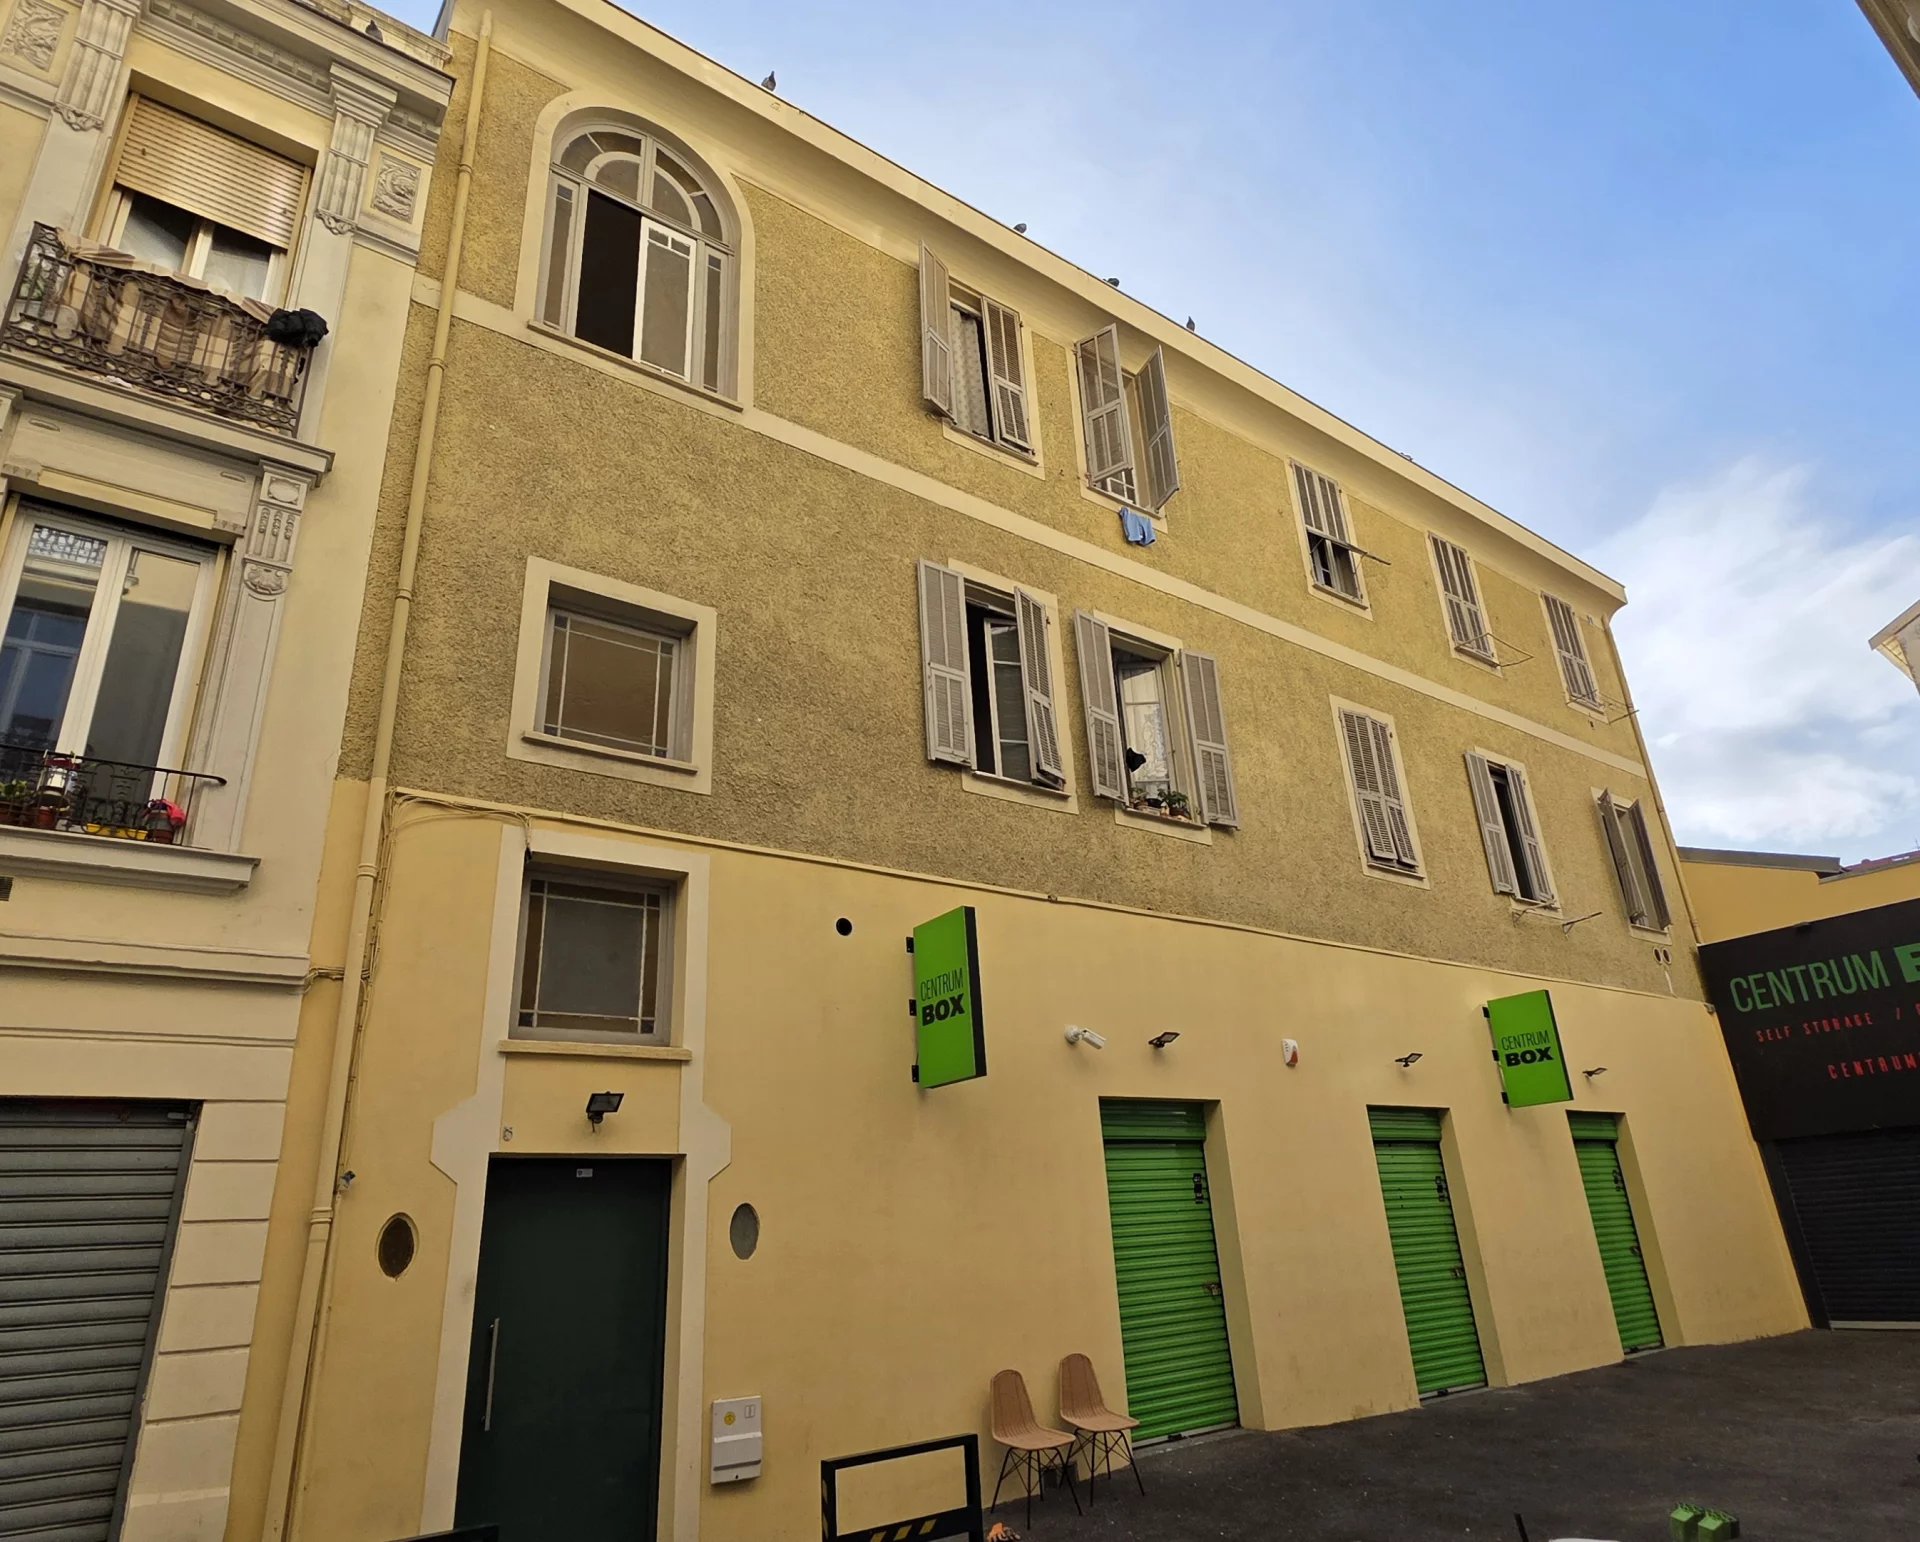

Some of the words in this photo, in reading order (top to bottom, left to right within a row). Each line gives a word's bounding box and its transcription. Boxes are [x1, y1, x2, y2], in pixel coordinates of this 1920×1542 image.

[920, 968, 963, 1001] CENTRUM
[1730, 951, 1890, 1012] CENTRUM
[922, 993, 965, 1026] BOX
[1501, 1030, 1550, 1051] CENTRUM
[1756, 1026, 1791, 1042] SELF
[1803, 1012, 1873, 1035] STORAGE
[1505, 1046, 1553, 1067] BOX
[1827, 1053, 1920, 1079] CENTRUM
